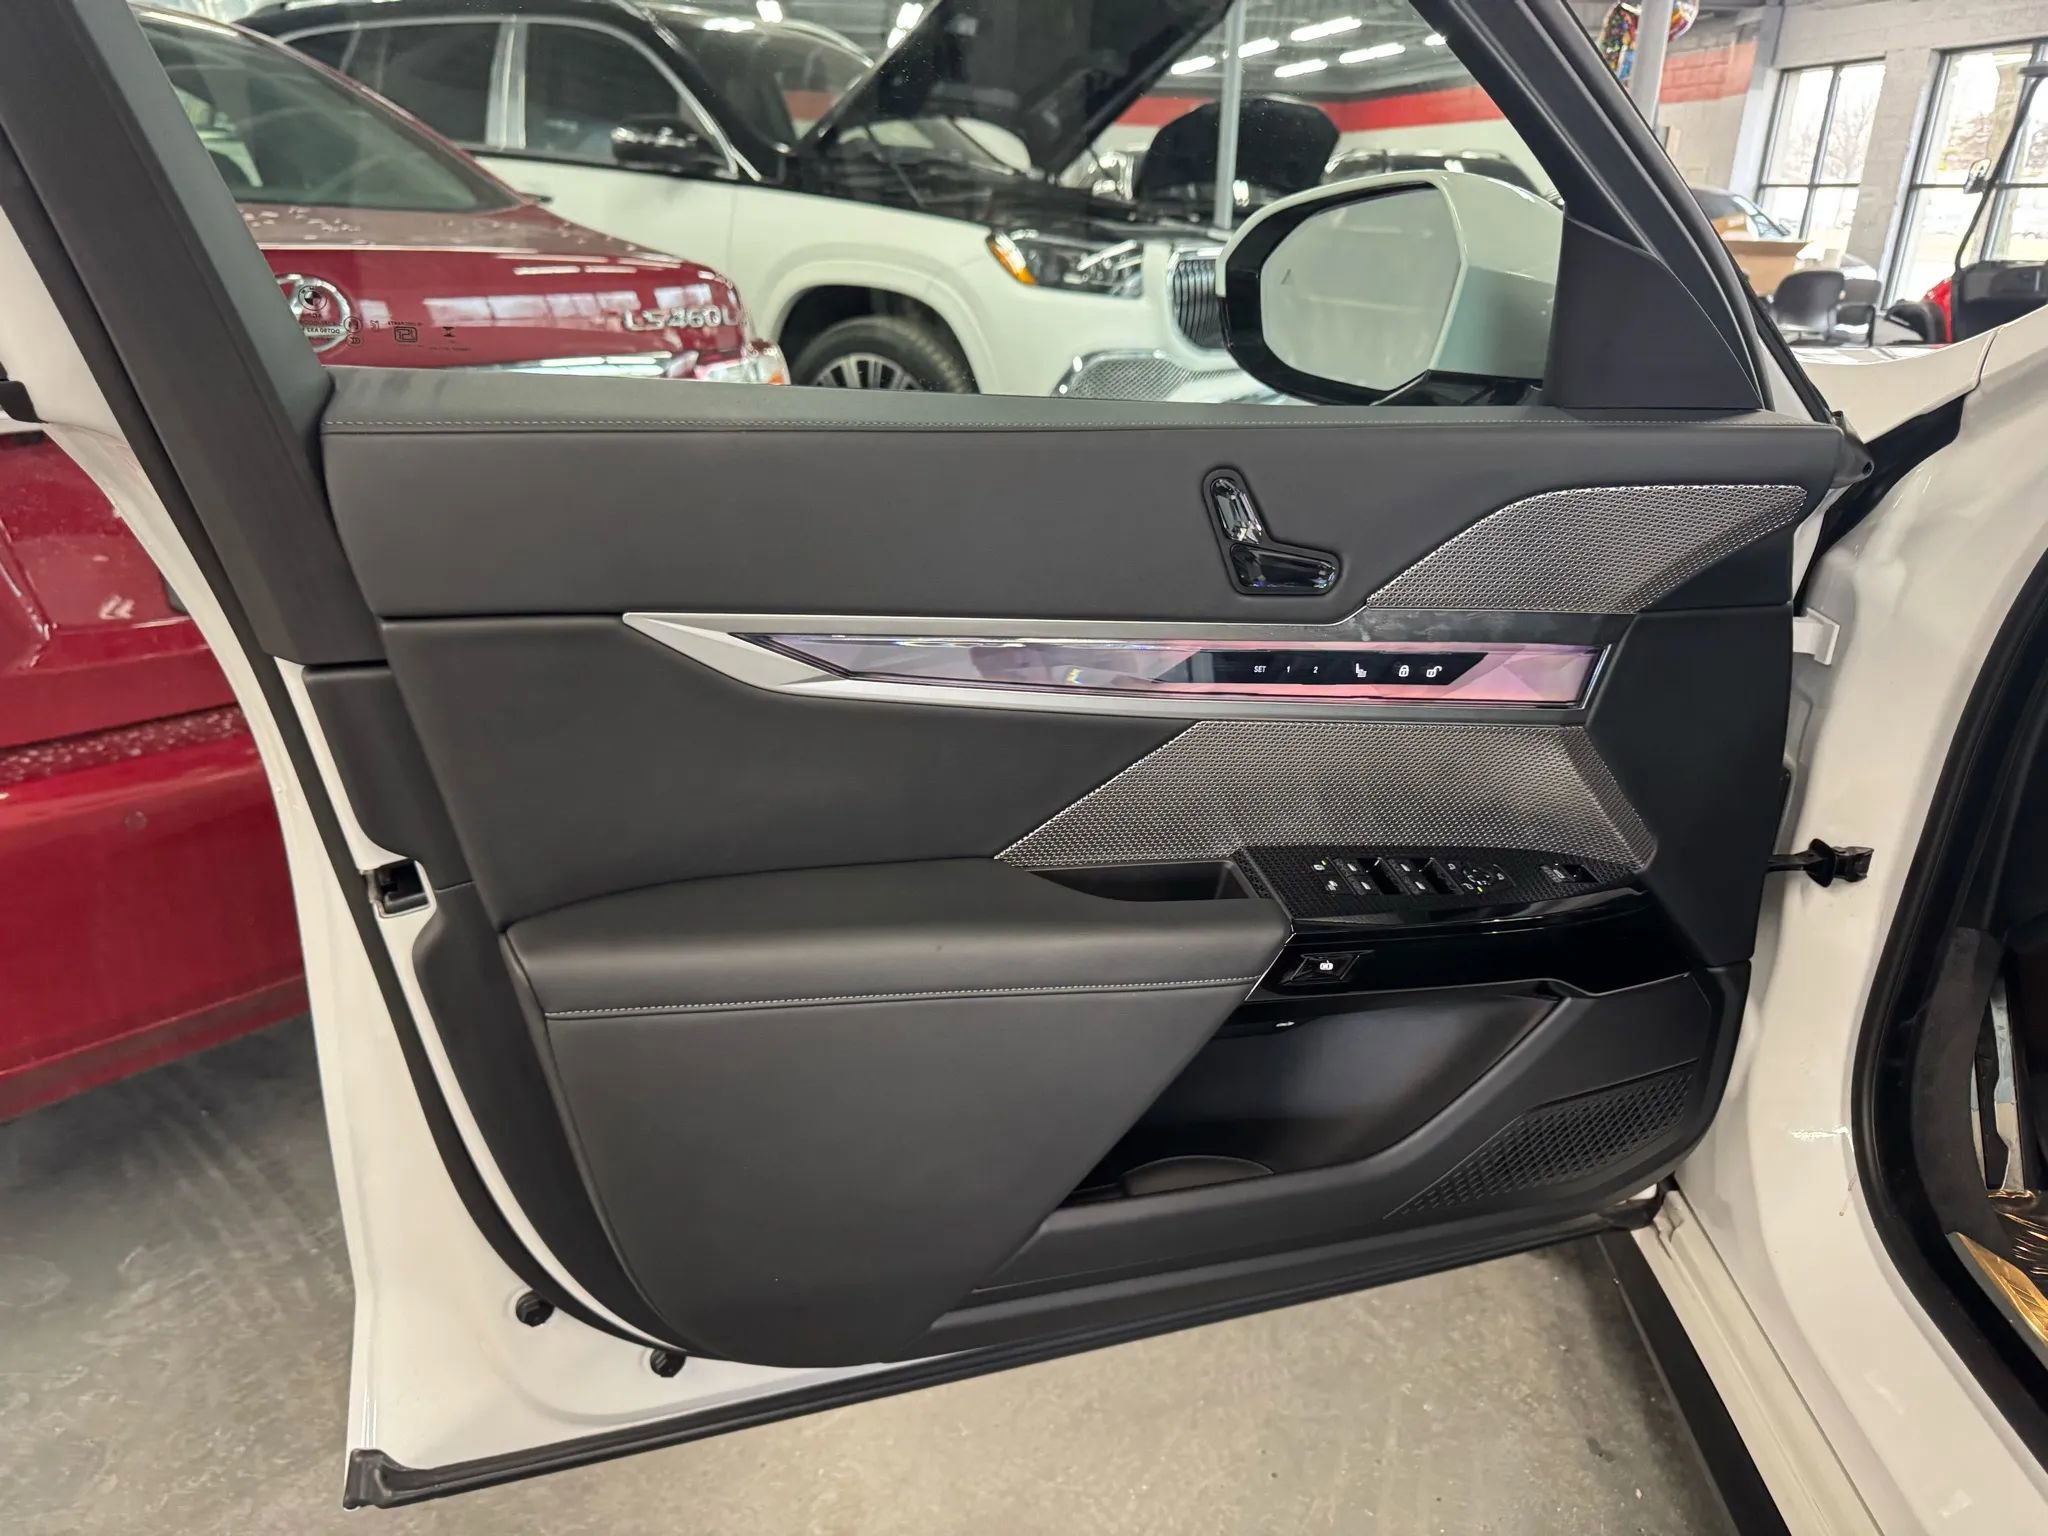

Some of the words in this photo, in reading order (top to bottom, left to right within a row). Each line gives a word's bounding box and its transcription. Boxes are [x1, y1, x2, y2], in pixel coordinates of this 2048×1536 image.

[1253, 665, 1267, 673] SET
[1286, 665, 1291, 673] 1
[1312, 666, 1319, 674] 2
